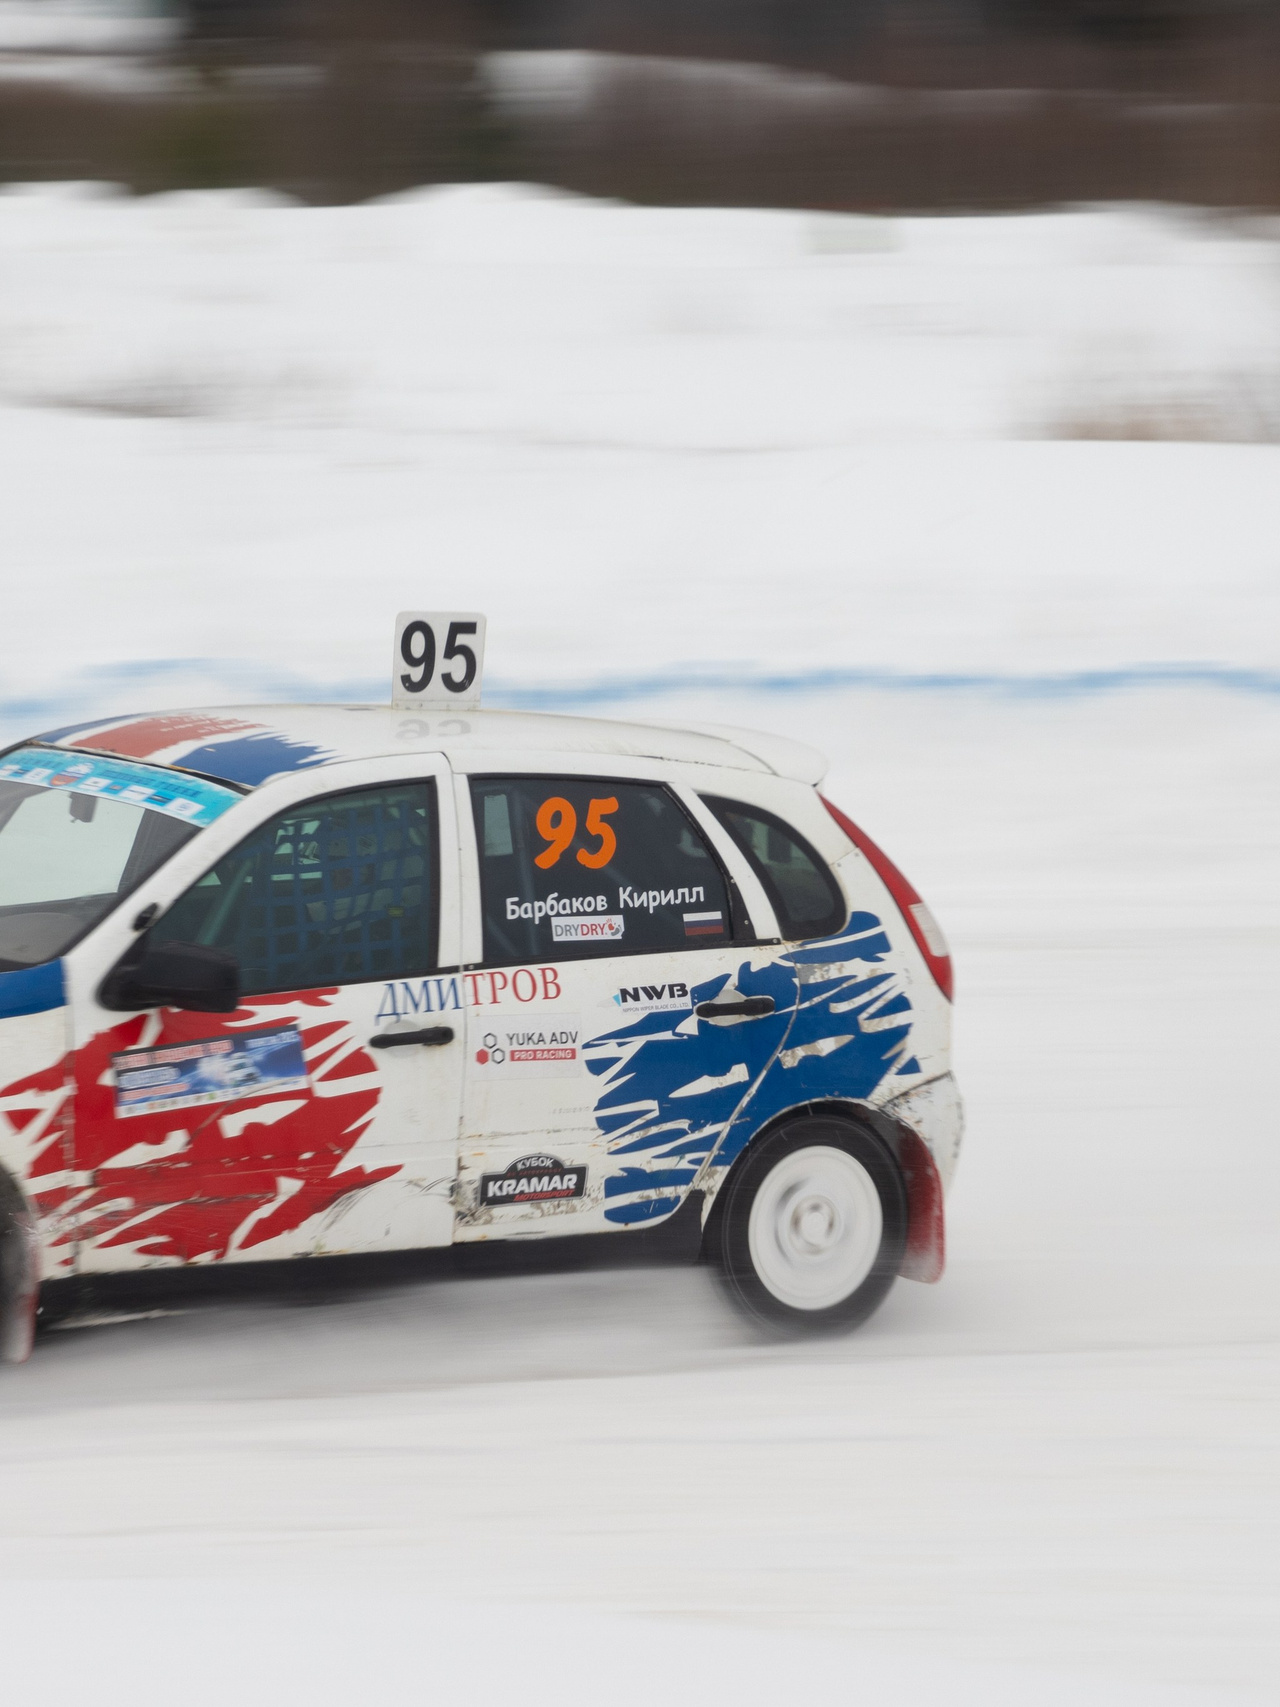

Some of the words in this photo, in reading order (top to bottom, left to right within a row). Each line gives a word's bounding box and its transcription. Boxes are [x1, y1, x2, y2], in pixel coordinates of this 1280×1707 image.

[400, 620, 477, 693] 95
[534, 796, 619, 869] 95
[506, 892, 608, 924] Барбаков
[619, 886, 705, 914] Кирилл
[375, 967, 562, 1026] ДМИТРОВ
[620, 983, 688, 1003] NWB
[506, 1032, 547, 1046] YUKA
[549, 1031, 578, 1045] ADV
[514, 1051, 534, 1060] PRO
[536, 1050, 572, 1059] RACING
[516, 1157, 554, 1171] КУБОК
[487, 1174, 578, 1197] KRAMAR
[513, 1190, 574, 1202] MOTORSPORT
